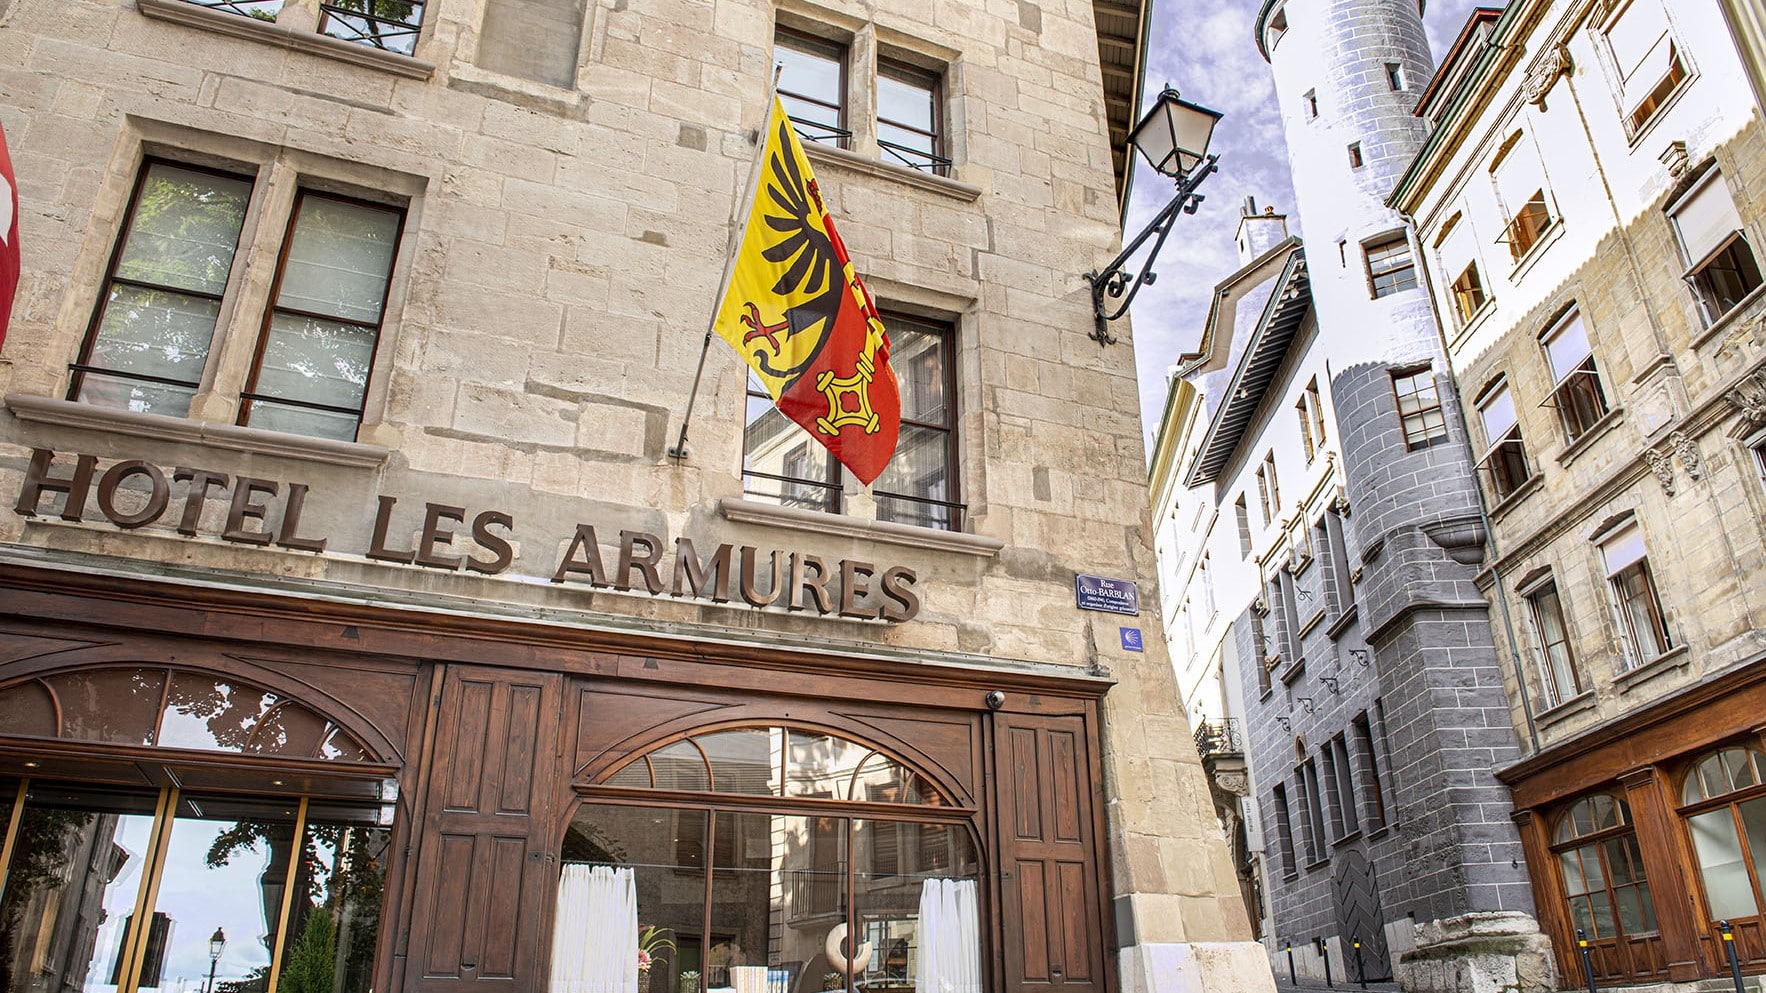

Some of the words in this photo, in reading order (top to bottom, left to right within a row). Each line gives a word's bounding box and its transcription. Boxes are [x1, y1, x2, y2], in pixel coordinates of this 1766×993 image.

[14, 449, 327, 553] HOTEL
[366, 496, 514, 575] LES
[550, 523, 920, 623] ARMURES
[1100, 579, 1115, 589] Rue
